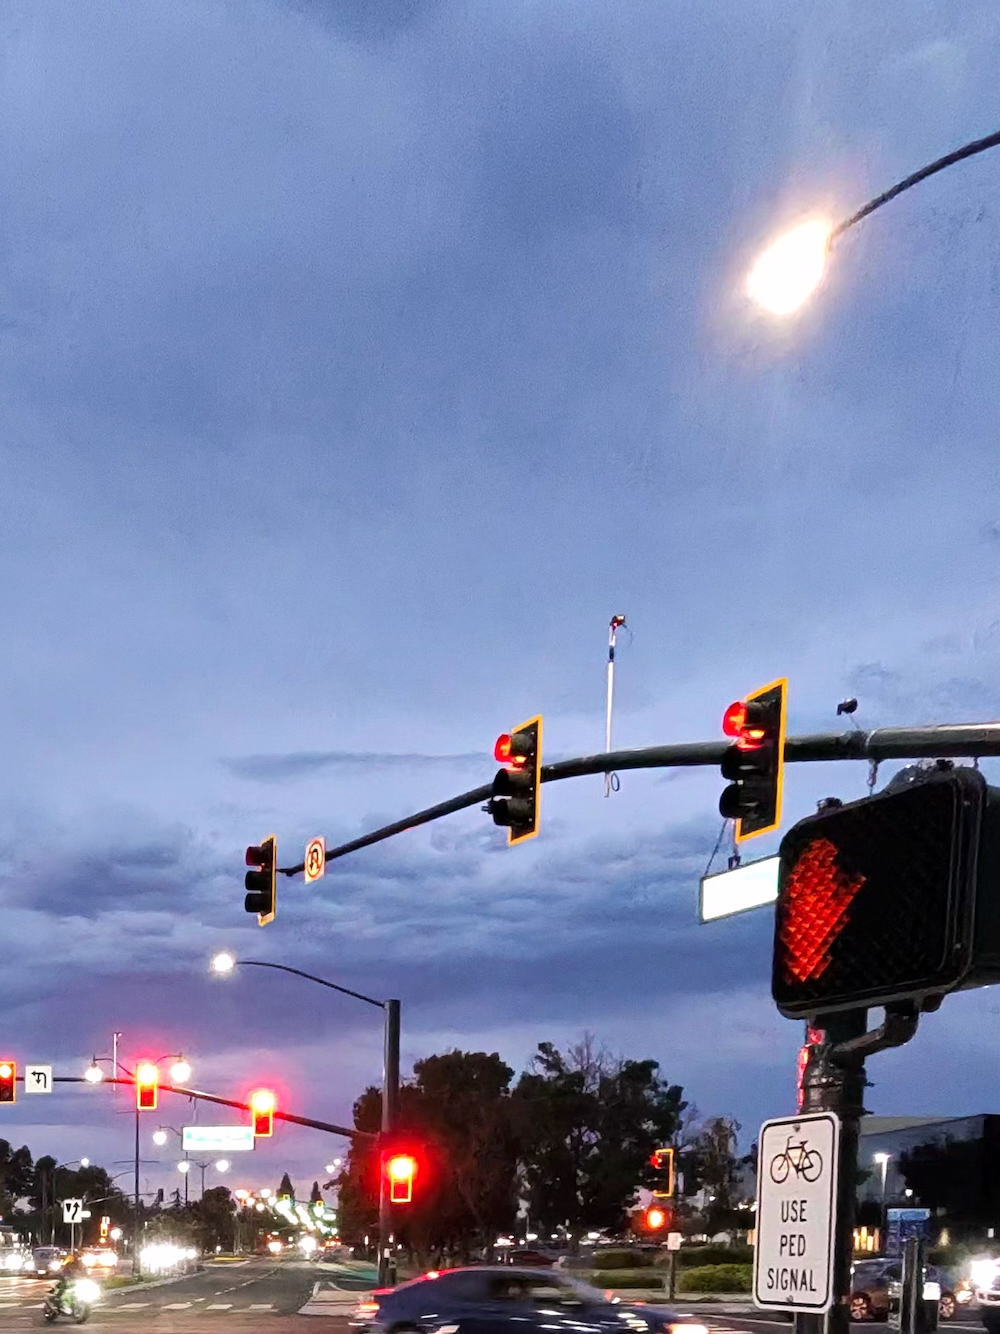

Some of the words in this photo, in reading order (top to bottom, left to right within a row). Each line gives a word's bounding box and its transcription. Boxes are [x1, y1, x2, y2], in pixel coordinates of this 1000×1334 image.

[781, 1200, 807, 1222] USE
[780, 1234, 806, 1257] PED
[767, 1268, 817, 1292] SIGNAL
